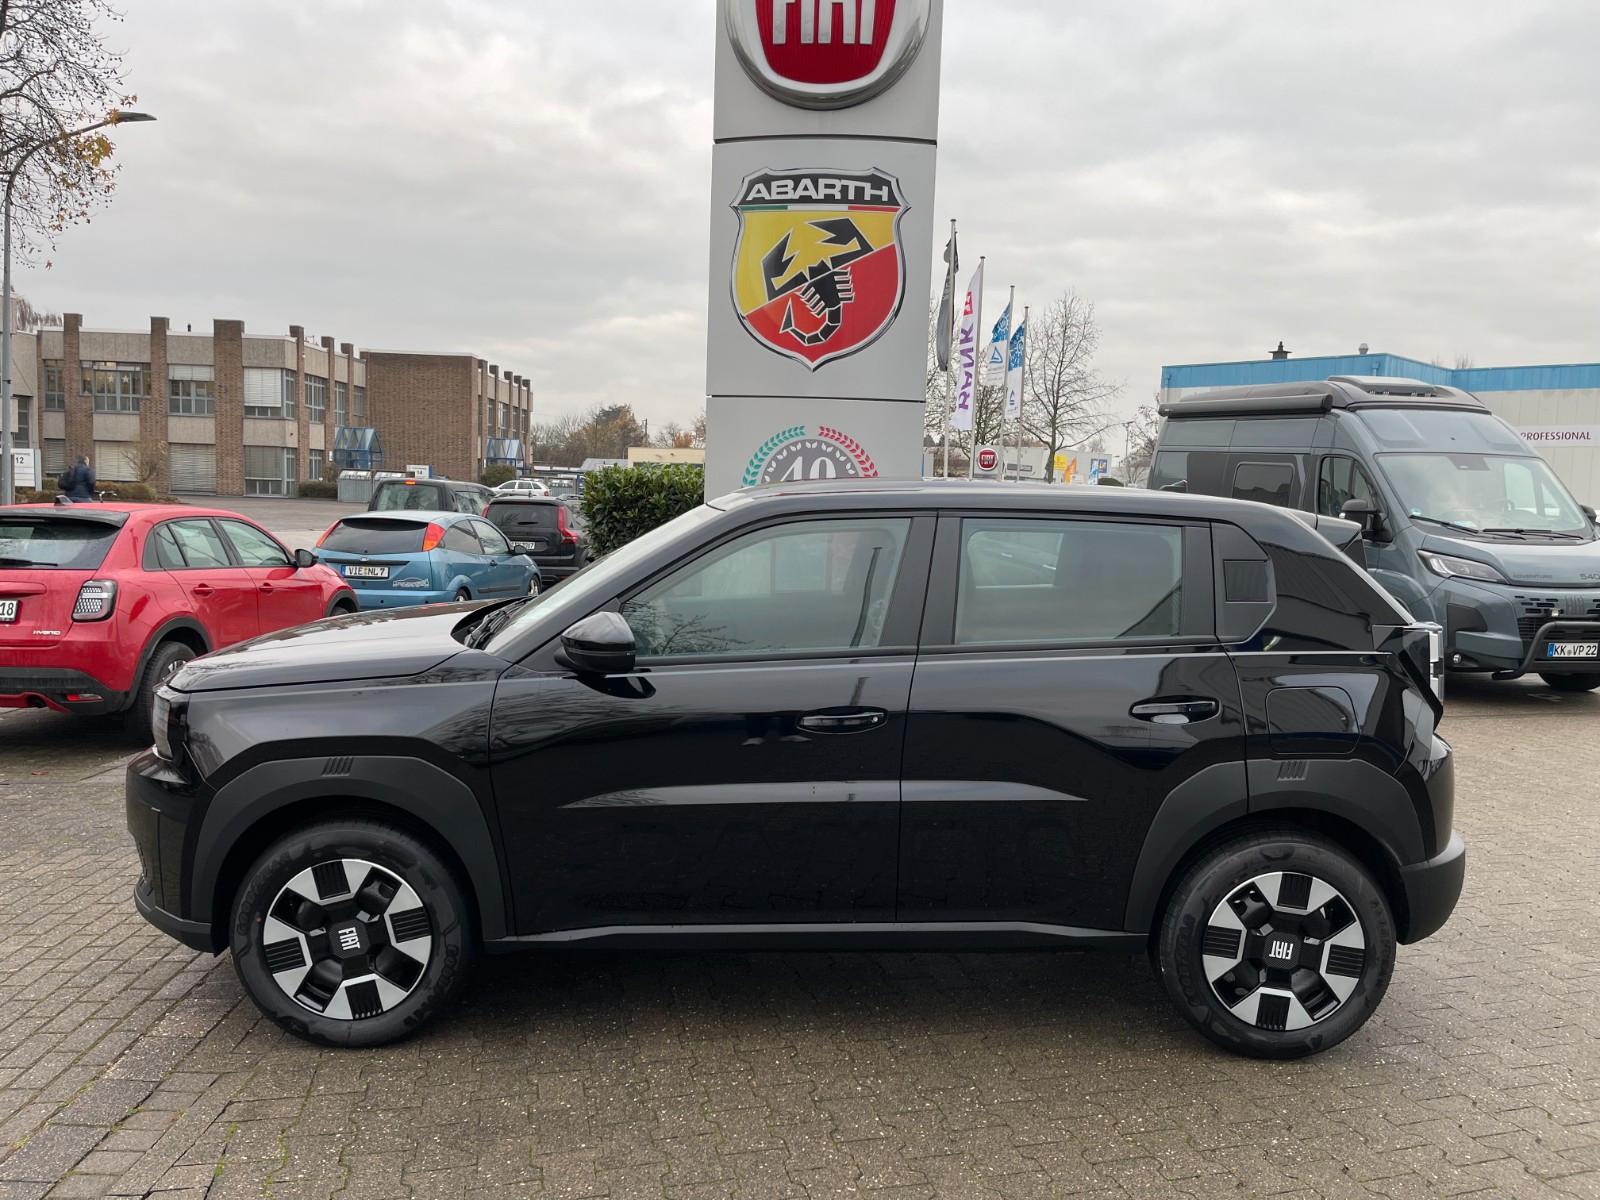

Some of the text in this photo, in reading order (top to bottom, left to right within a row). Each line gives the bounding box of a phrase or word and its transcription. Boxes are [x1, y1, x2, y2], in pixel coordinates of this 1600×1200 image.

[745, 178, 889, 202] ABARTH
[1520, 431, 1592, 441] PROFESSIONAL
[15, 456, 25, 464] 12
[348, 567, 385, 576] VIE NL 7
[0, 602, 14, 616] 18
[1553, 645, 1597, 656] KK VP 22
[338, 926, 361, 951] FIAT
[1268, 940, 1294, 960] FIAT
